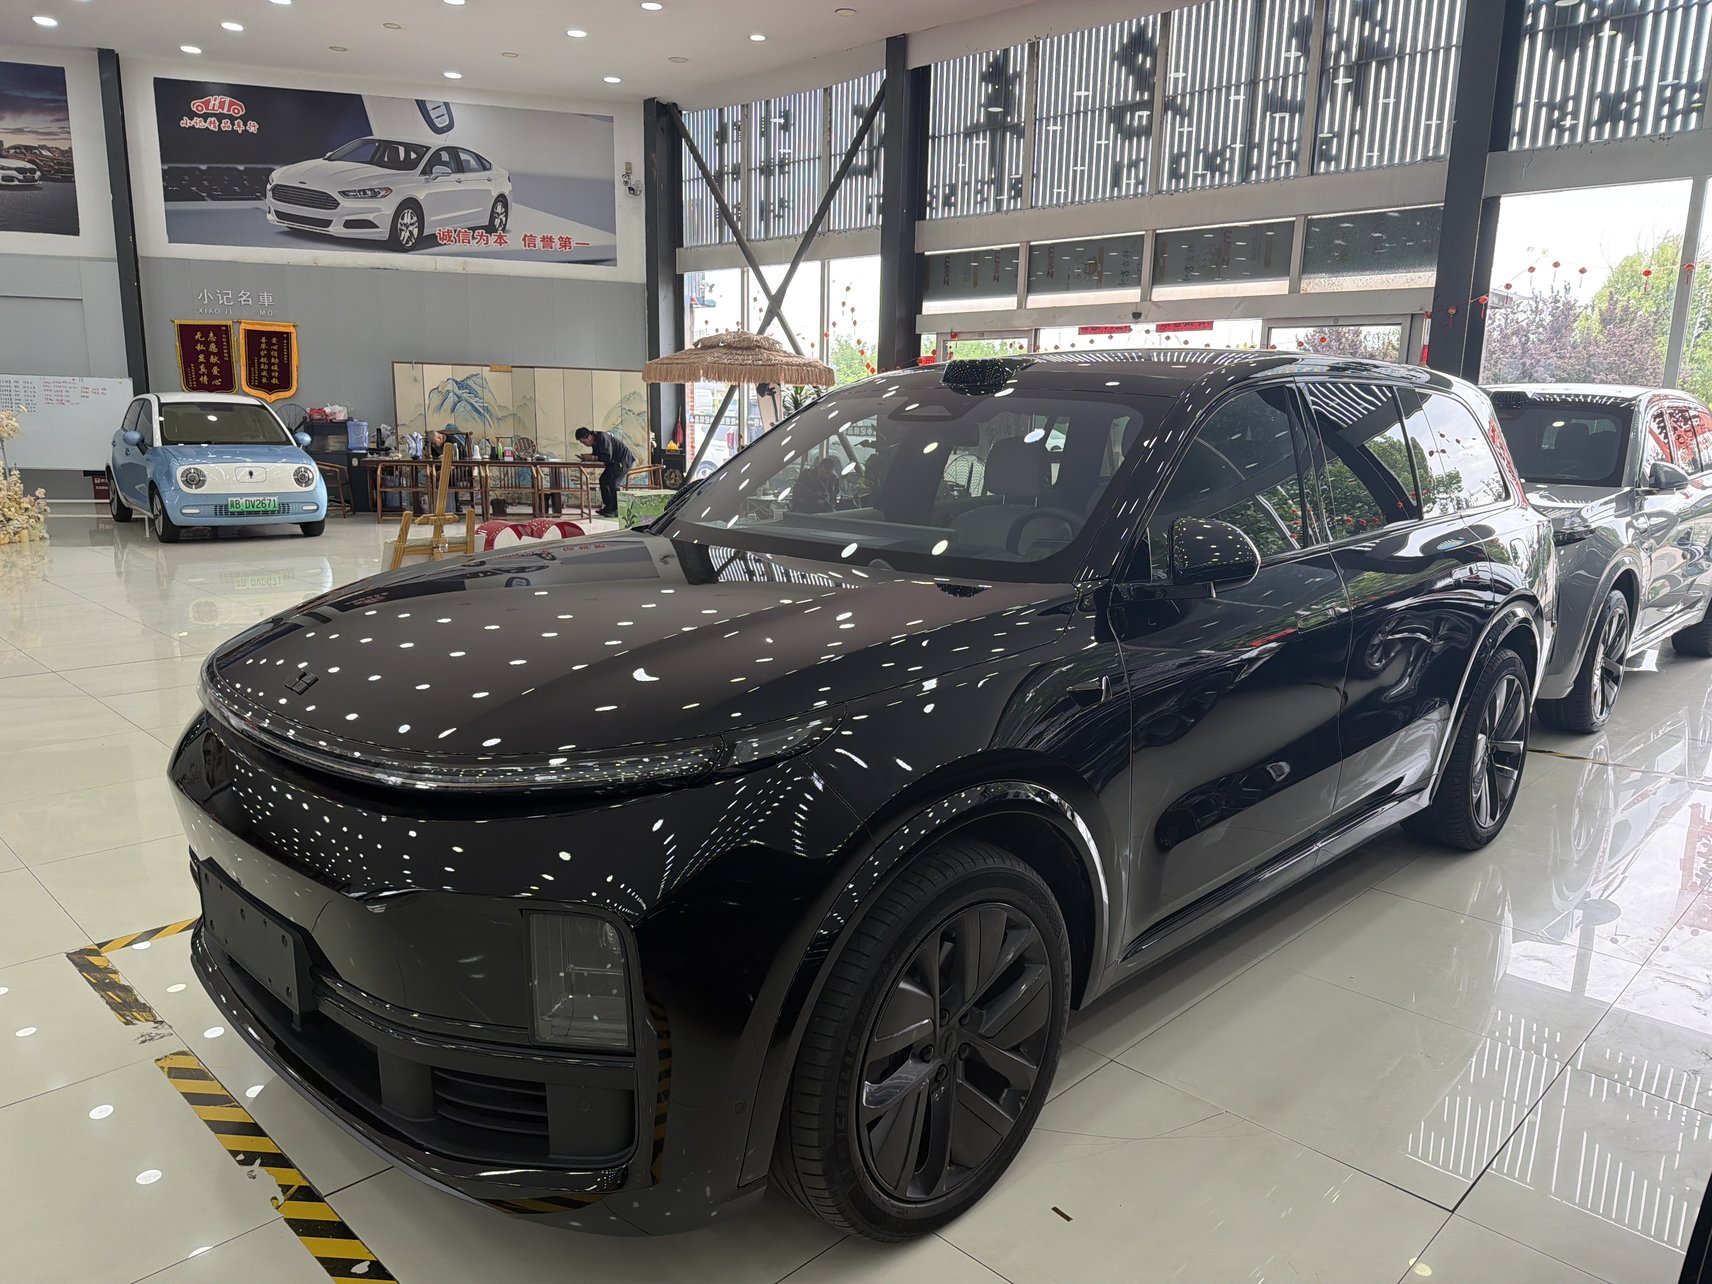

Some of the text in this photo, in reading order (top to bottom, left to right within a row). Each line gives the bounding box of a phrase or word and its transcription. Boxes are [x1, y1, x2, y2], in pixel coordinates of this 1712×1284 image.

[180, 116, 259, 134] 小记精品车行
[436, 227, 592, 251] 诚信为本 信誉第一
[198, 288, 275, 307] 小记名車
[198, 307, 221, 315] XIAO
